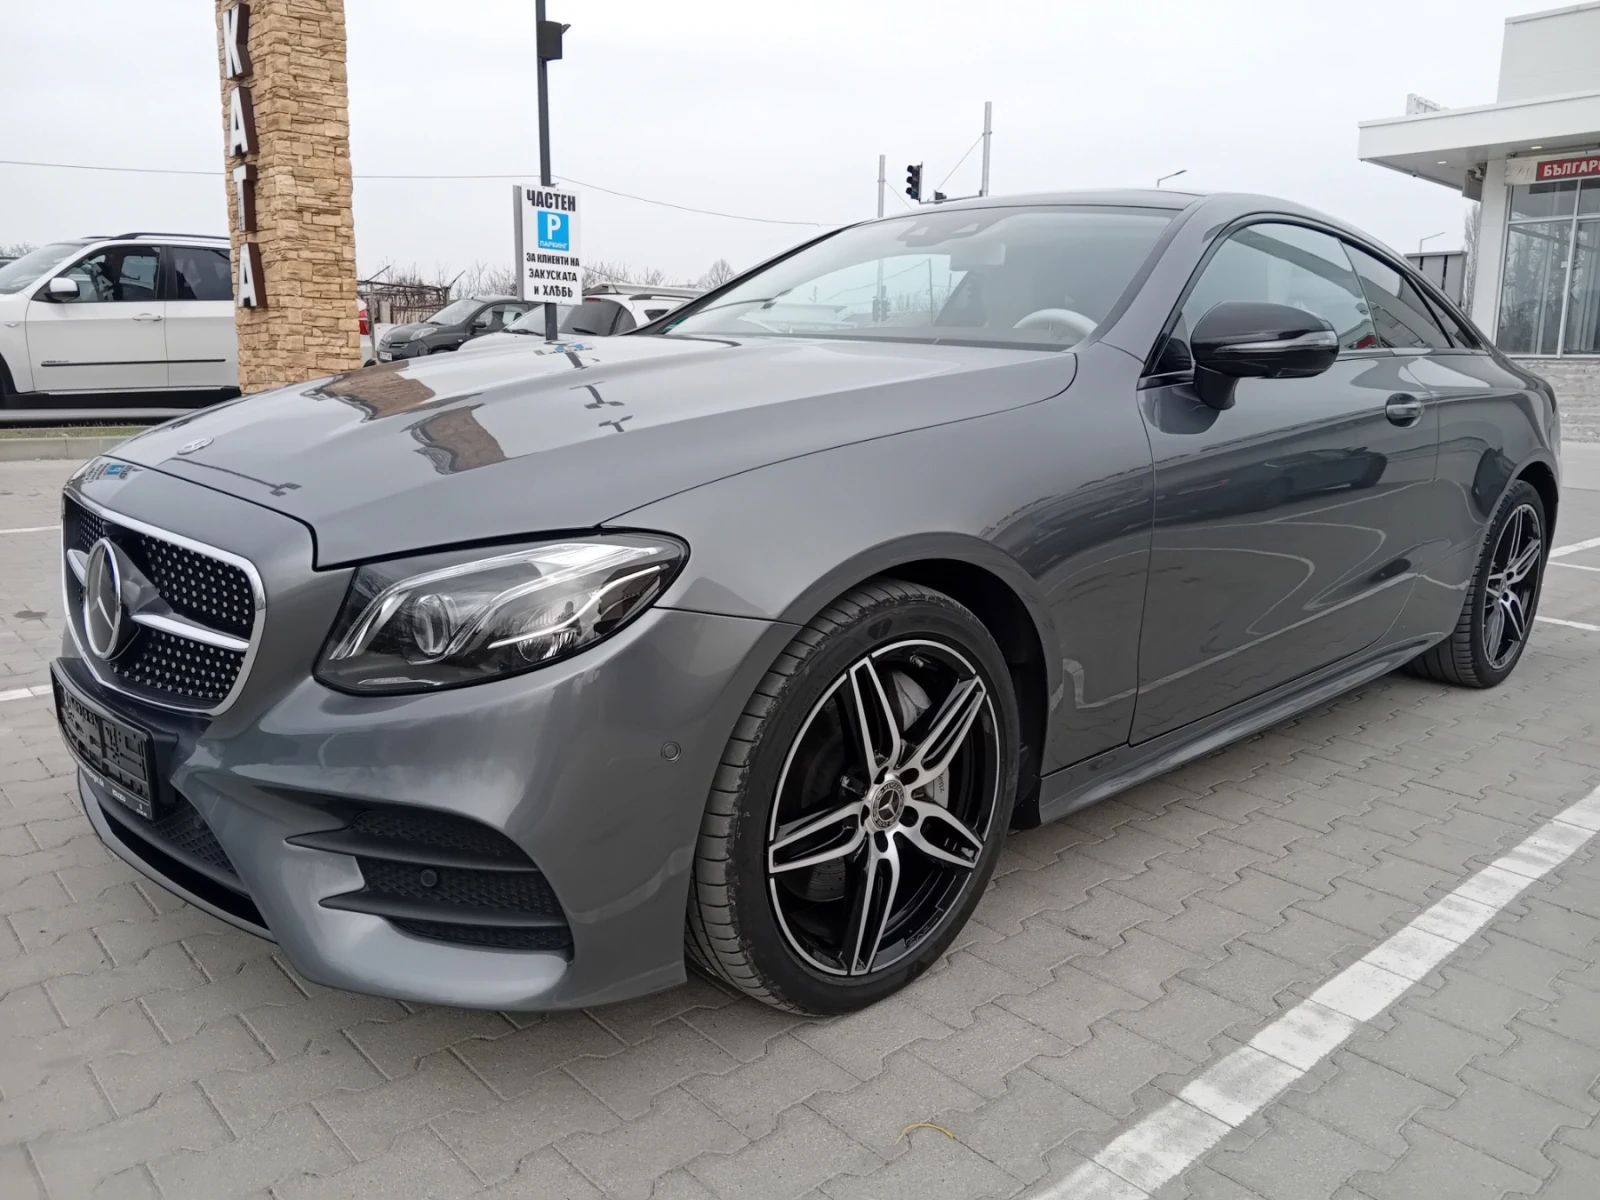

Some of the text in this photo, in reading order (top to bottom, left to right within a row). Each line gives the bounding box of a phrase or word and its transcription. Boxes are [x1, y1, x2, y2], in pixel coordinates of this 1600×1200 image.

[1543, 160, 1600, 177] БЪЛГАР
[526, 189, 576, 212] ЧАСТЕН
[546, 213, 561, 240] P
[539, 240, 568, 249] ПАРКИНГ
[526, 252, 580, 267] ЗА КЛИЕНТИ НА
[528, 268, 578, 282] ЗАКУСКАТА
